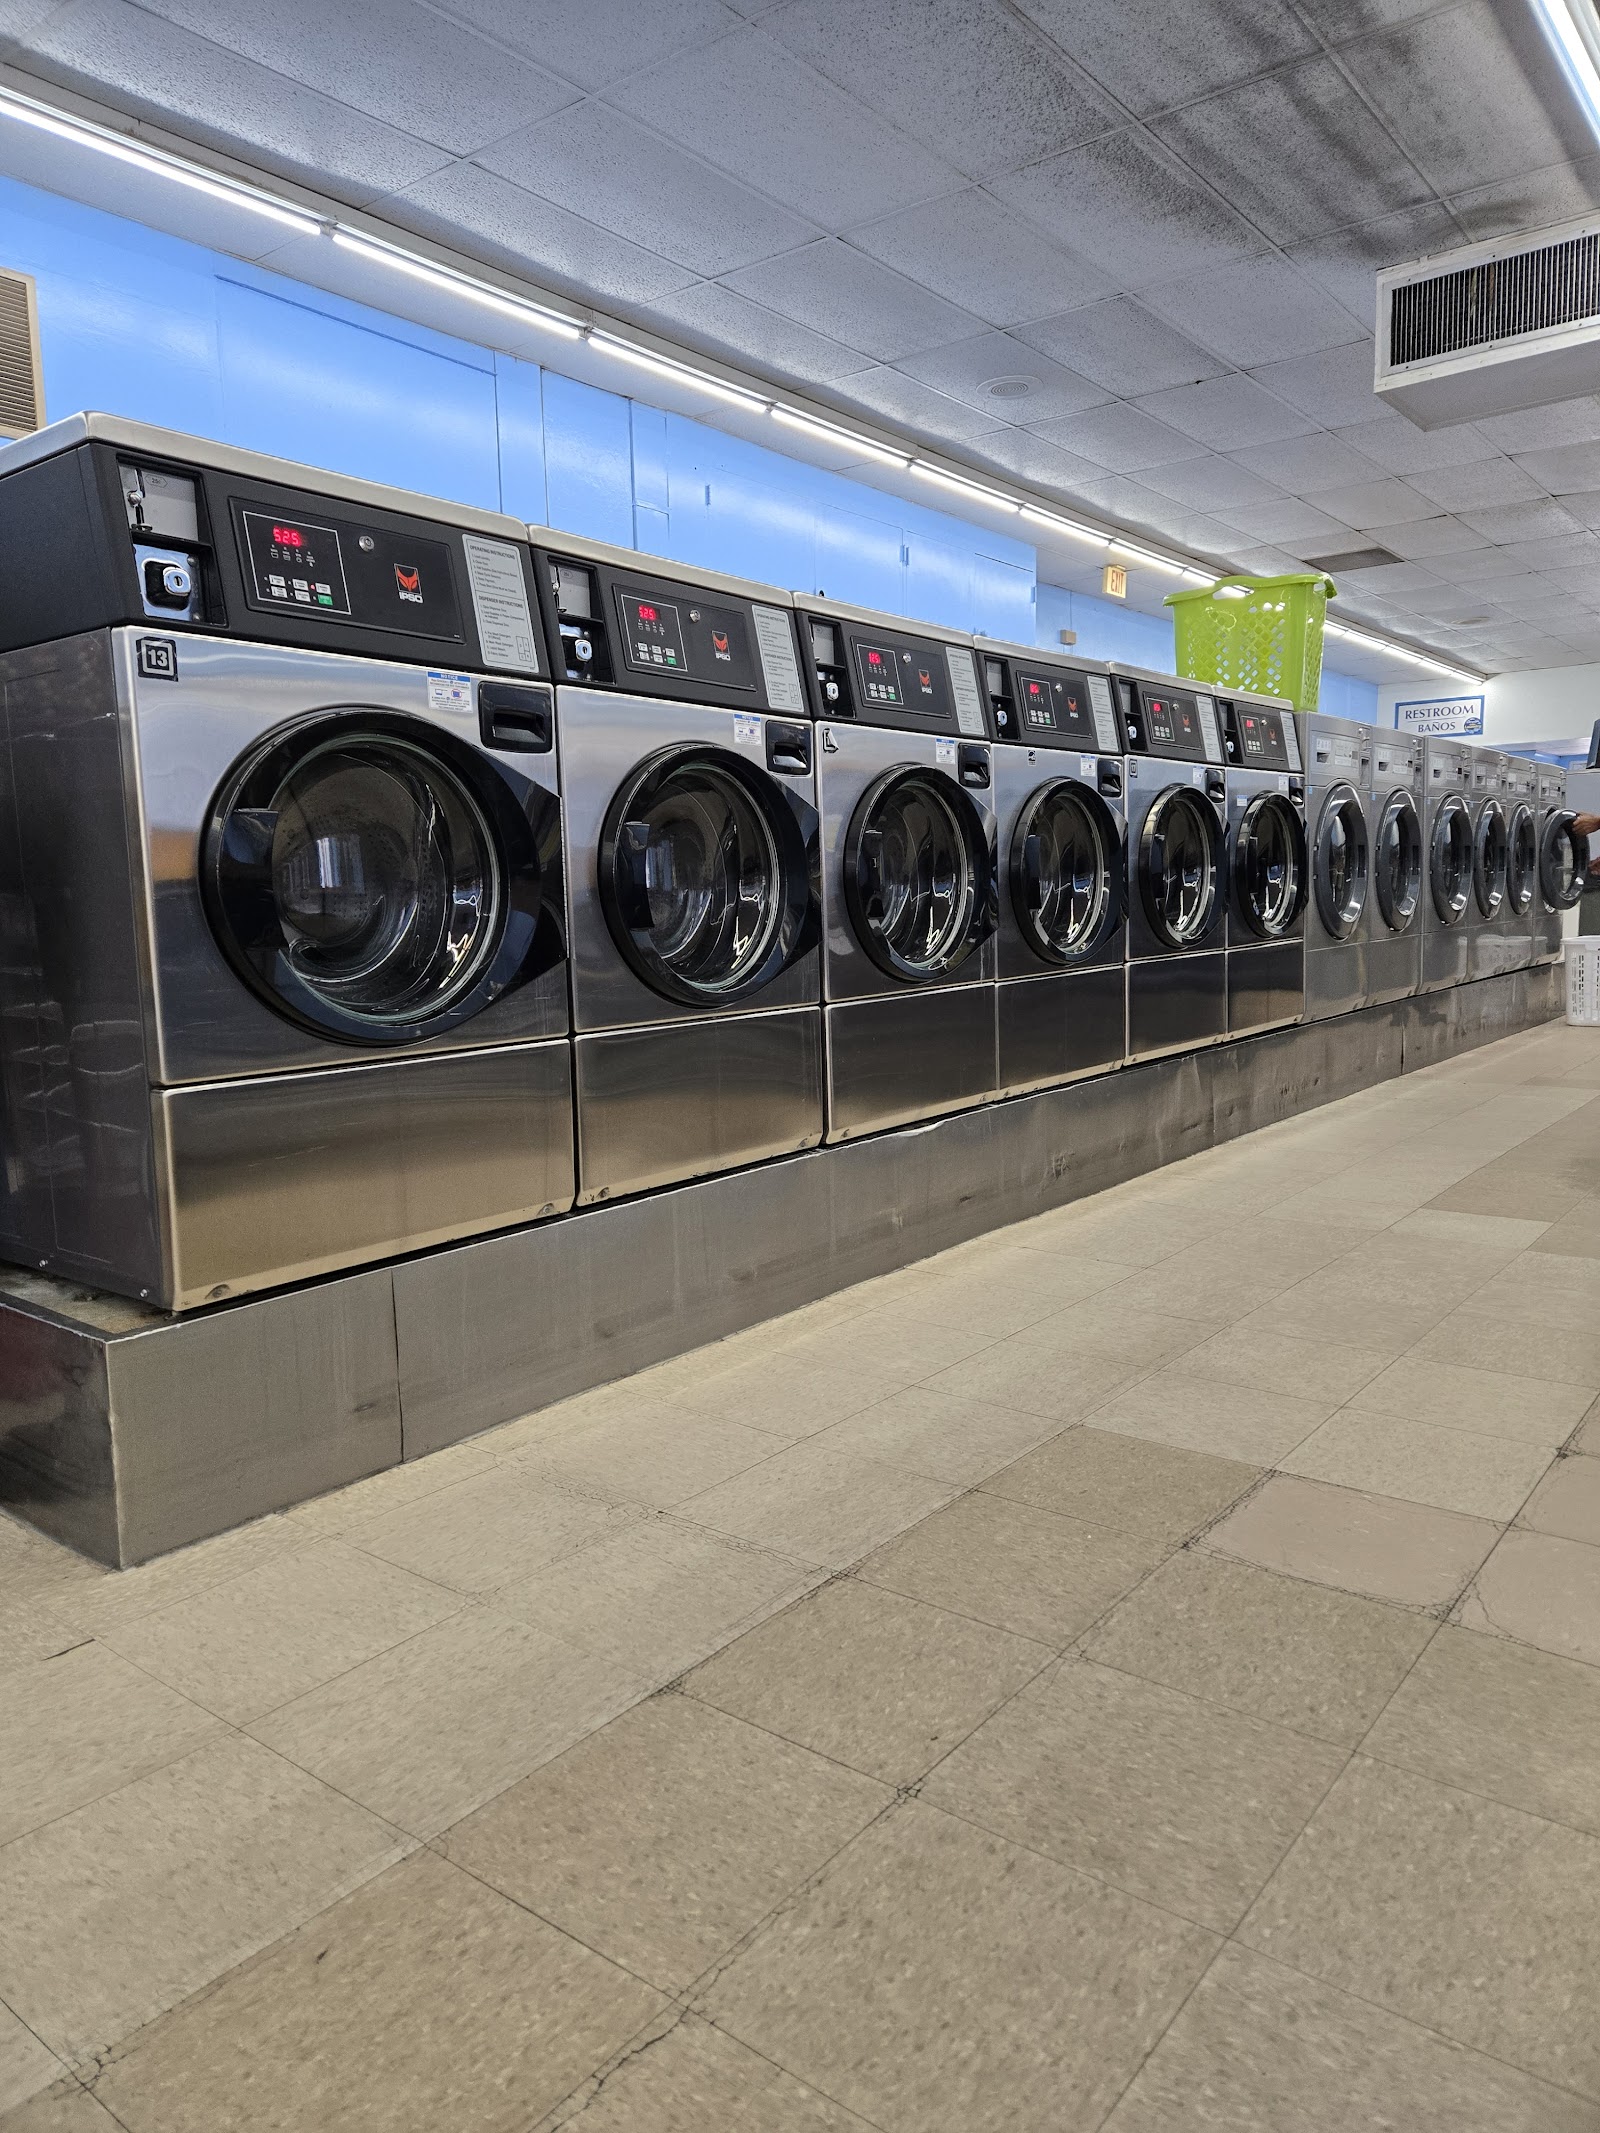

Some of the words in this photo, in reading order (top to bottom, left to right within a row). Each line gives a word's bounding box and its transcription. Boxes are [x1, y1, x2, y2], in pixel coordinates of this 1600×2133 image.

[273, 526, 300, 546] 525
[469, 544, 490, 554] OPERATING
[490, 549, 516, 560] INSTRUCTIONS
[1110, 569, 1124, 595] EXIT
[399, 591, 424, 604] IPSO
[478, 595, 499, 604] DISPENSER
[499, 599, 524, 609] INSTRUCTIONS
[147, 649, 168, 667] 13
[715, 652, 731, 661] IPSO
[1405, 704, 1474, 720] RESTROOM
[1417, 721, 1456, 733] BAÑOS
